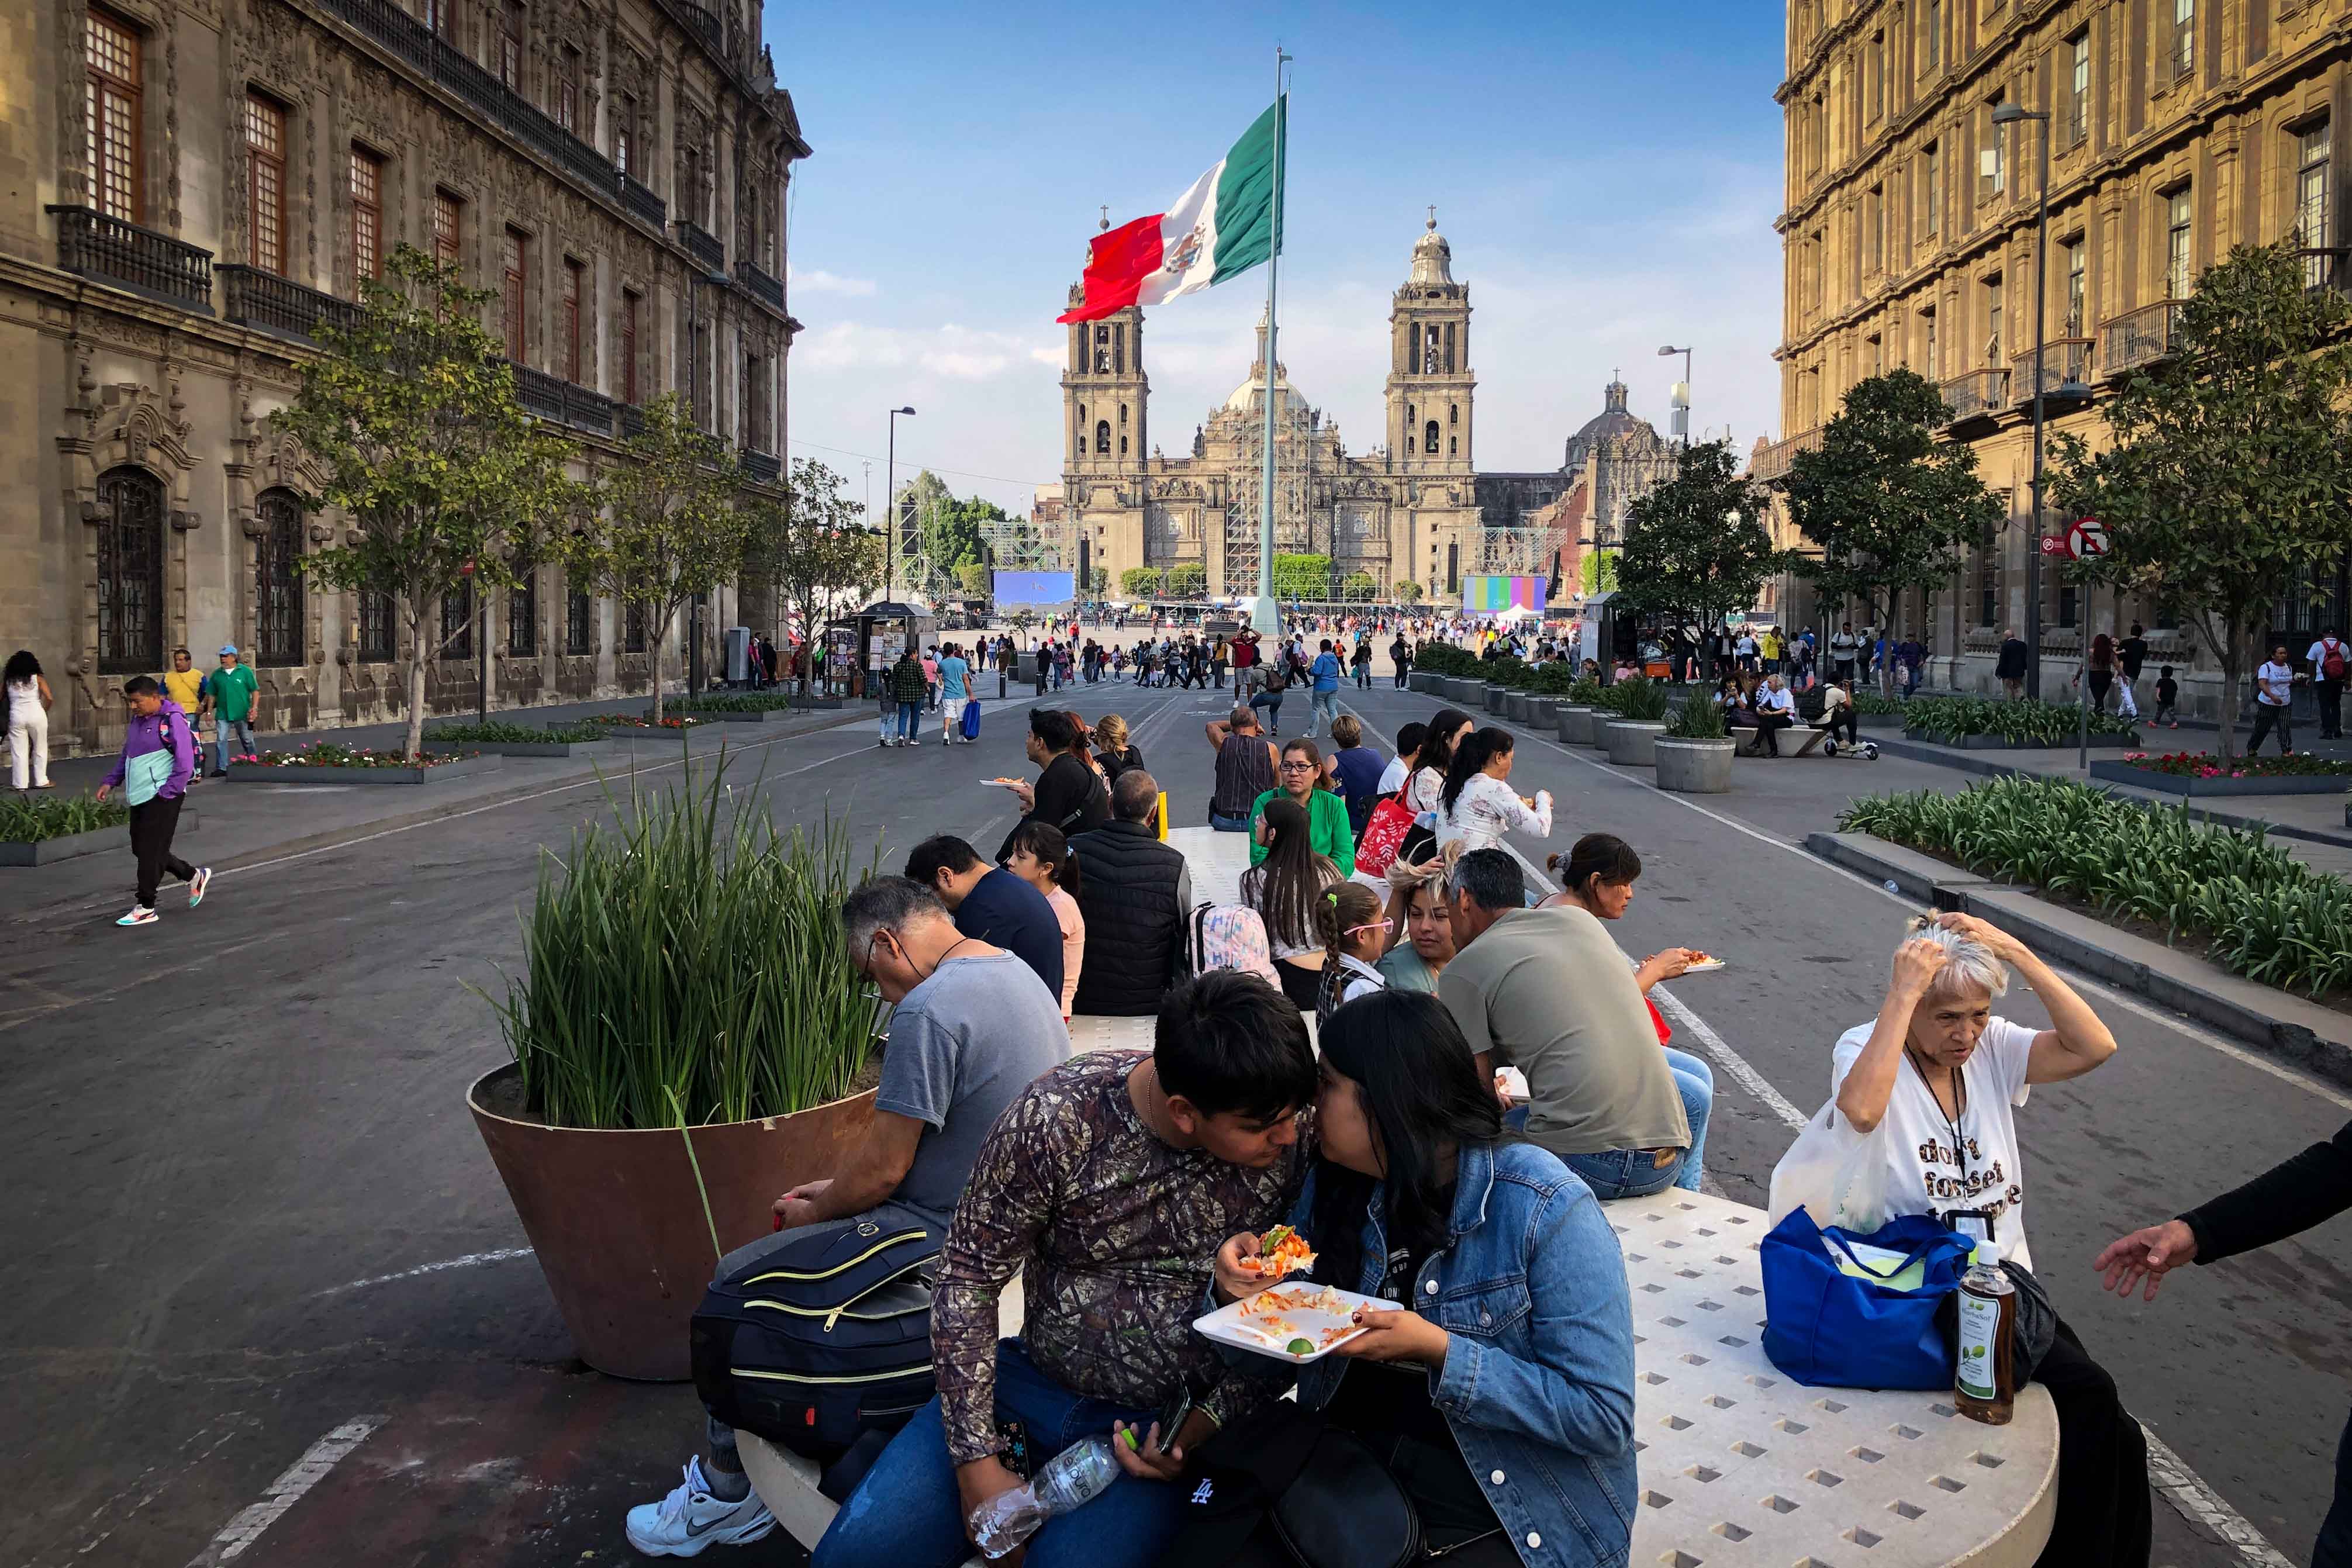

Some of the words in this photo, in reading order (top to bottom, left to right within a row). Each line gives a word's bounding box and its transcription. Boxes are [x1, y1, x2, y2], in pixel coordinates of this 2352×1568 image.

[1924, 1159, 2005, 1198] forget
[1384, 1286, 1400, 1298] LON
[1191, 1478, 1213, 1504] LA
